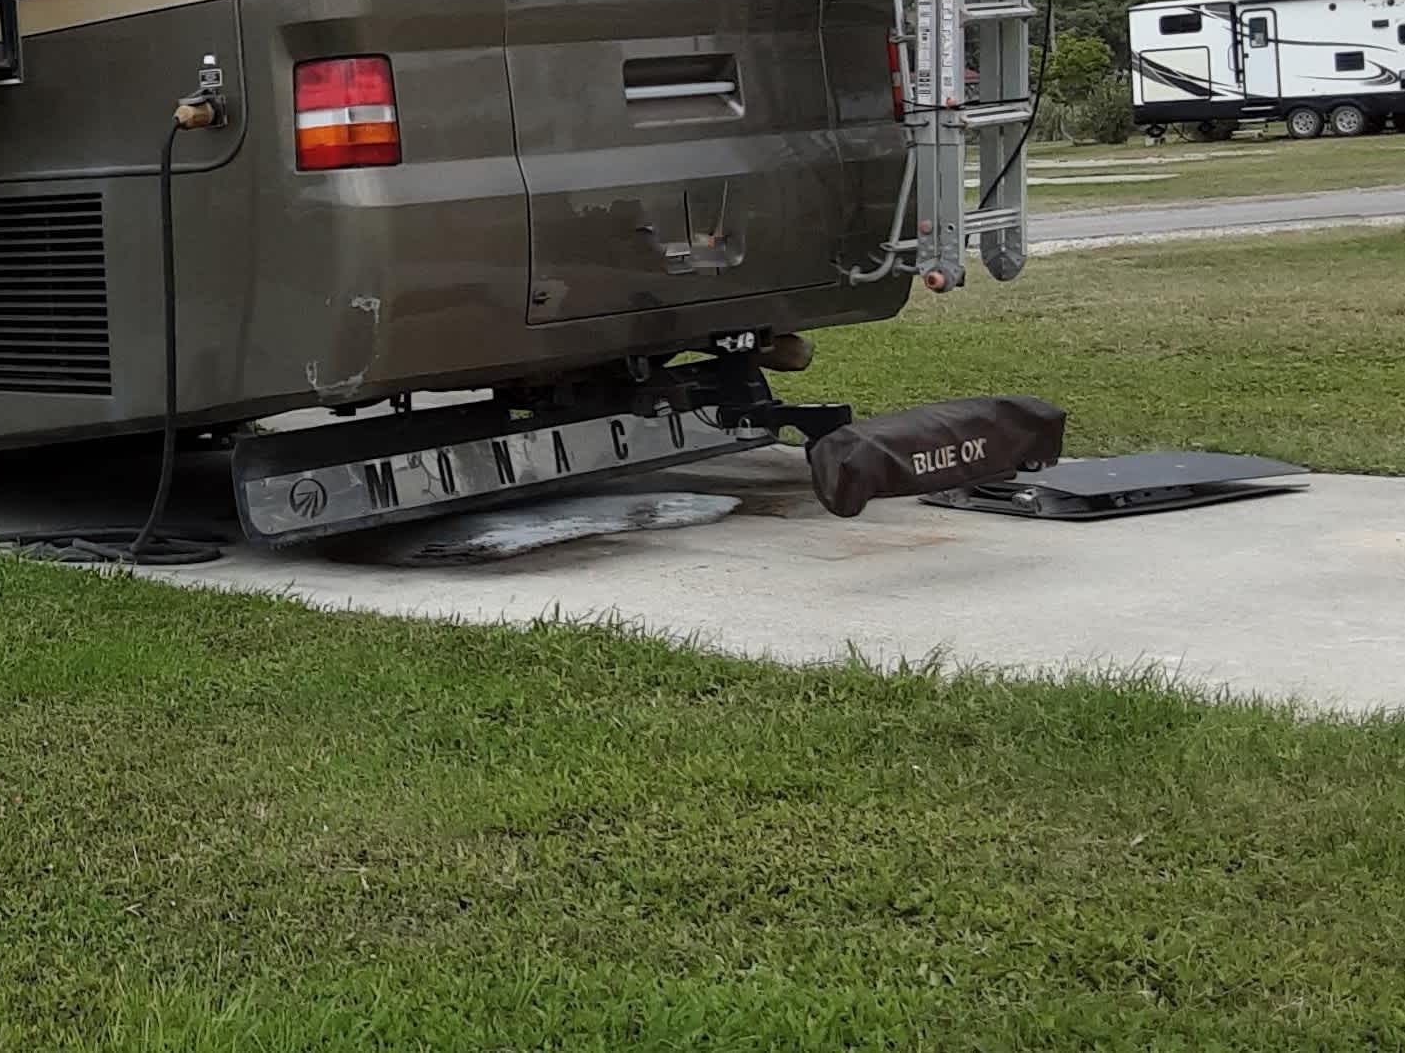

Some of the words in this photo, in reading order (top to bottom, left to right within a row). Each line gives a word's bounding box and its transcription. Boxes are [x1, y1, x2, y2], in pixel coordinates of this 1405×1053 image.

[366, 411, 686, 509] MONACO
[912, 445, 957, 475] BLUE
[961, 437, 987, 463] OX
